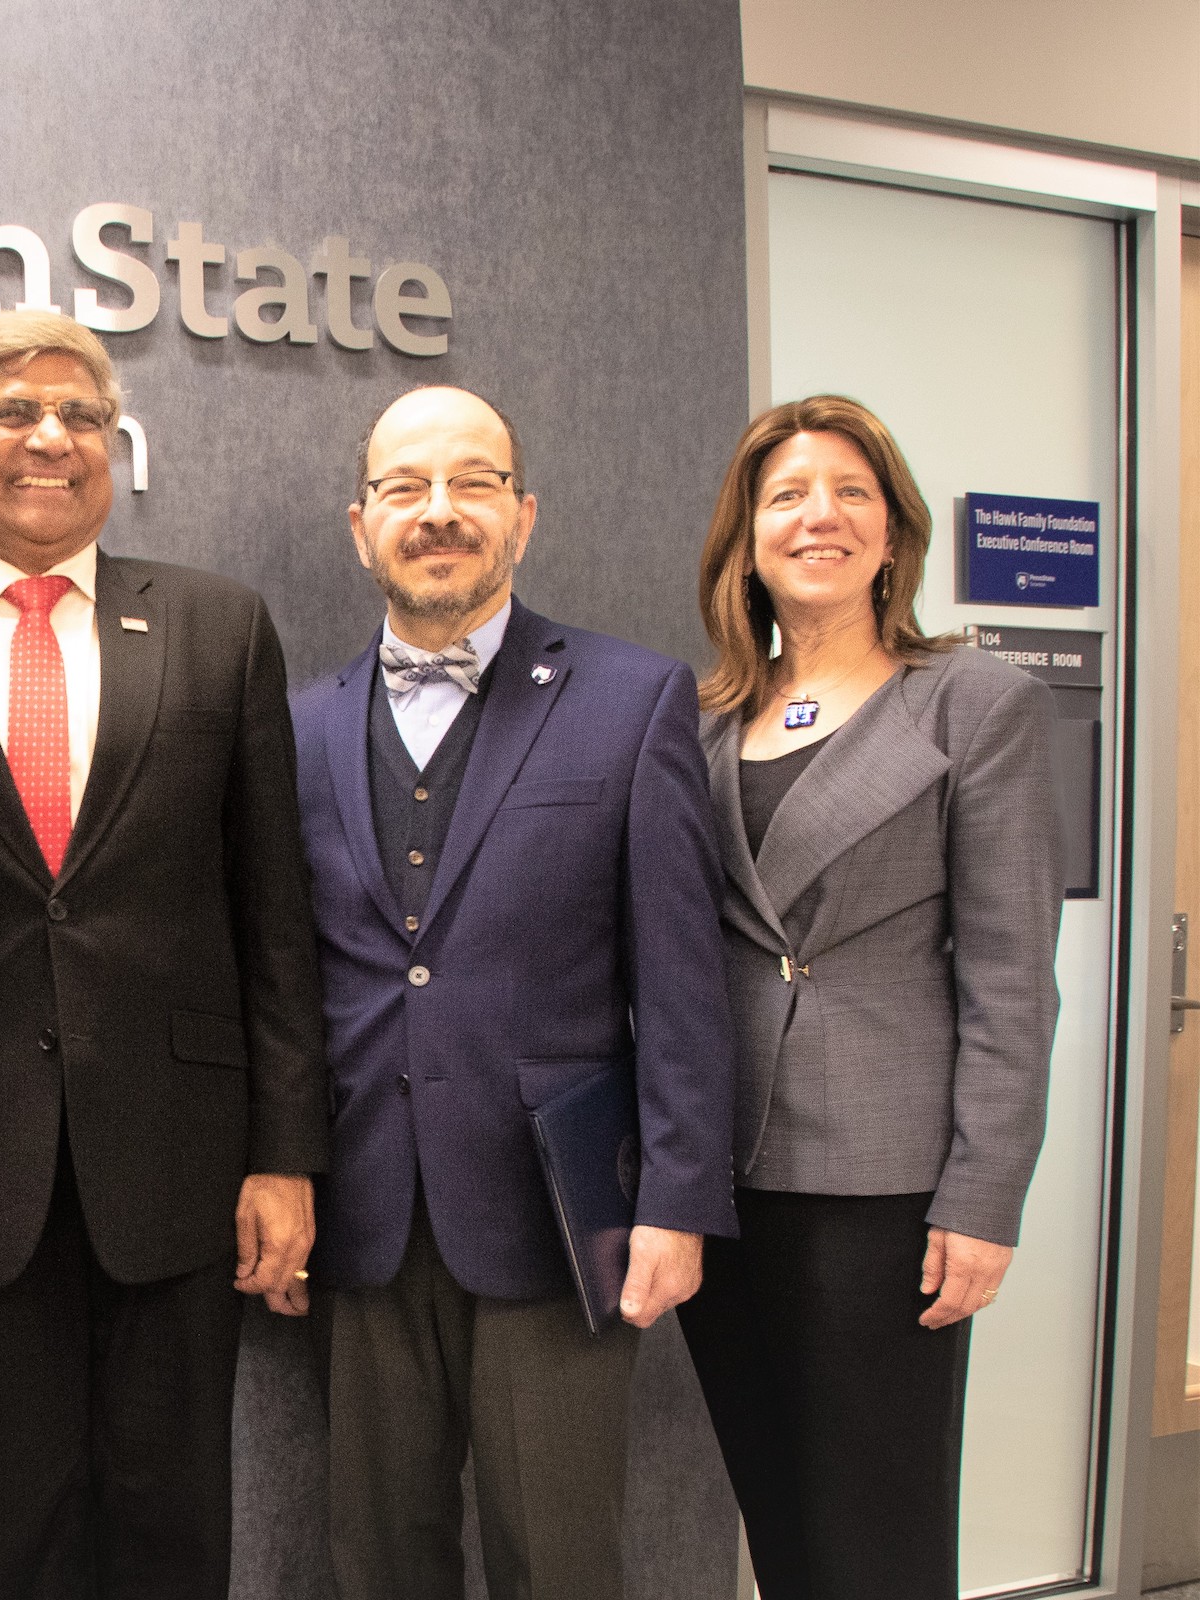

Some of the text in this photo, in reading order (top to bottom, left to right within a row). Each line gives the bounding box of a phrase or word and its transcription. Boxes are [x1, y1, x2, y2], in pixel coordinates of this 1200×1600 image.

[975, 509, 1095, 533] The Hawk Family Foundation
[977, 533, 1094, 556] Executive Conference Room
[980, 632, 1001, 646] 104
[1052, 653, 1082, 668] ROOM
